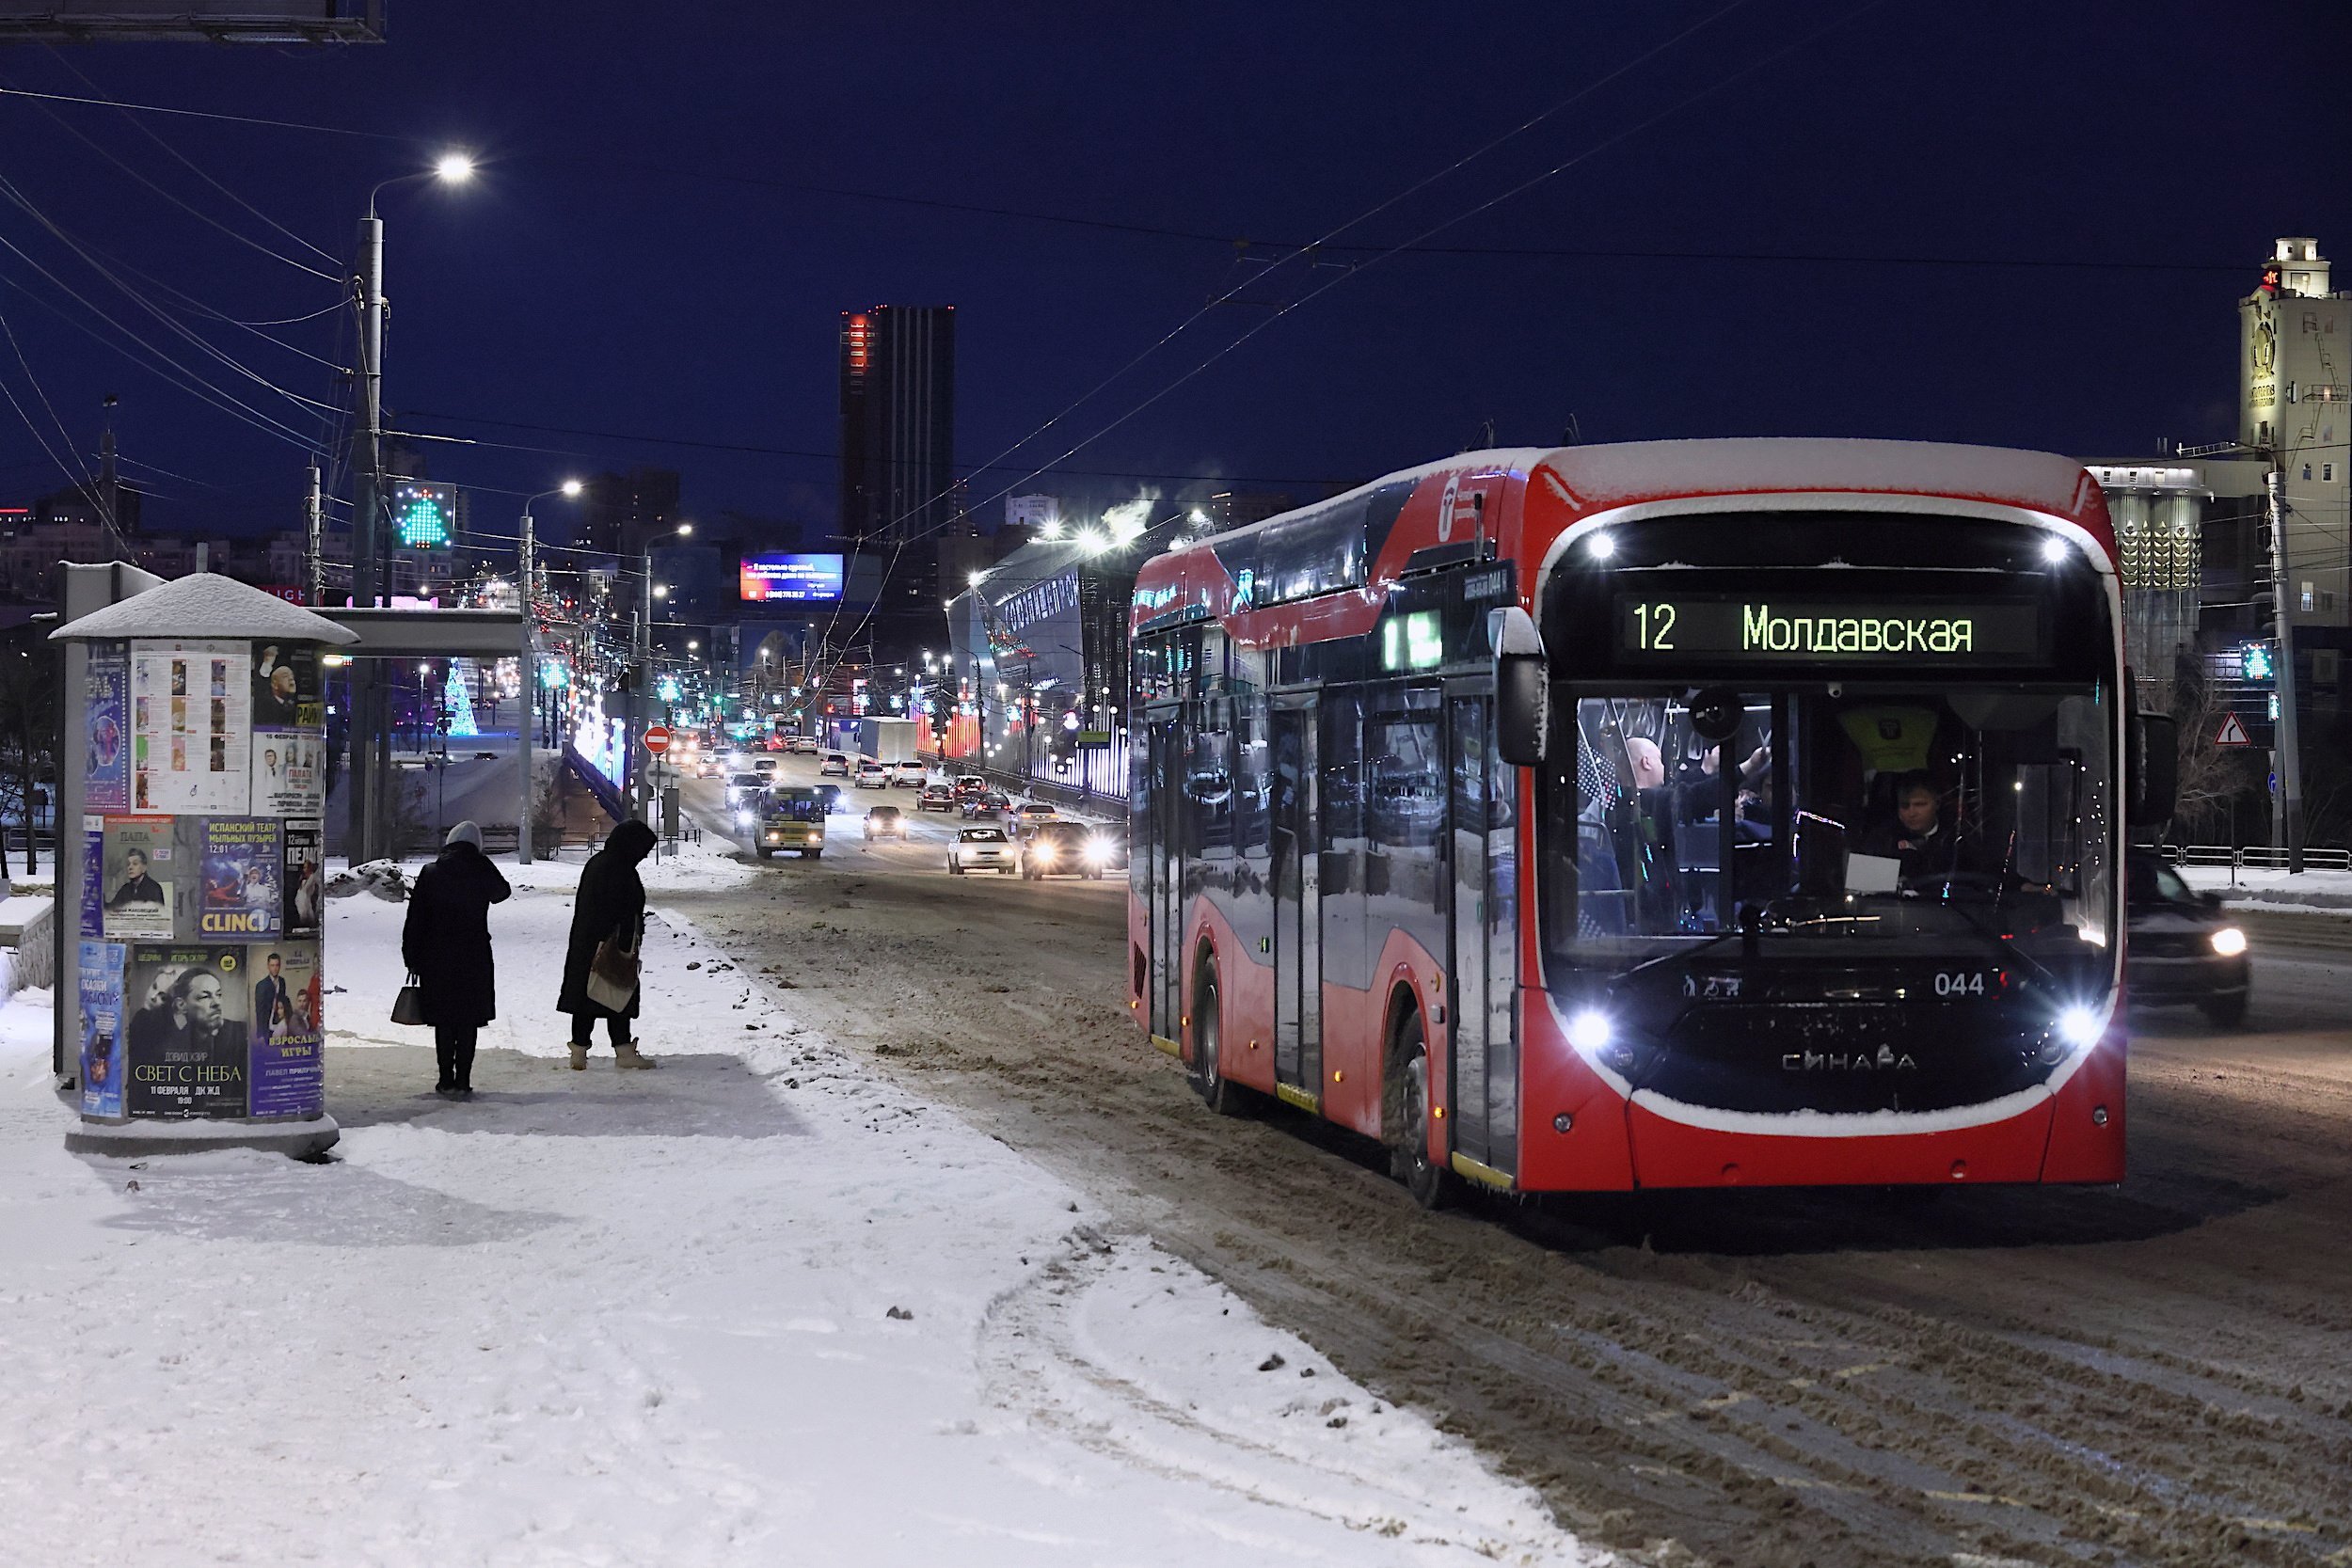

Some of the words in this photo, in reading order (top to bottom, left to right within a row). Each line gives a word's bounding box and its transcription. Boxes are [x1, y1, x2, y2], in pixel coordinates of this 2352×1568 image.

[1633, 603, 1675, 651] 12
[1742, 603, 1974, 654] Молдавская
[209, 822, 255, 833] ИСПАНСКИЙ
[257, 822, 277, 832] ТЕАТР
[119, 832, 151, 842] ПАПА
[1934, 973, 1985, 996] 044
[281, 1046, 312, 1058] ИГРЫ
[1782, 1052, 1917, 1070] СИНАРА
[135, 1064, 175, 1083] СВЕТ
[178, 1065, 192, 1083] С
[197, 1065, 242, 1082] НЕБА
[156, 1085, 189, 1095] ФЕВРАЛЯ
